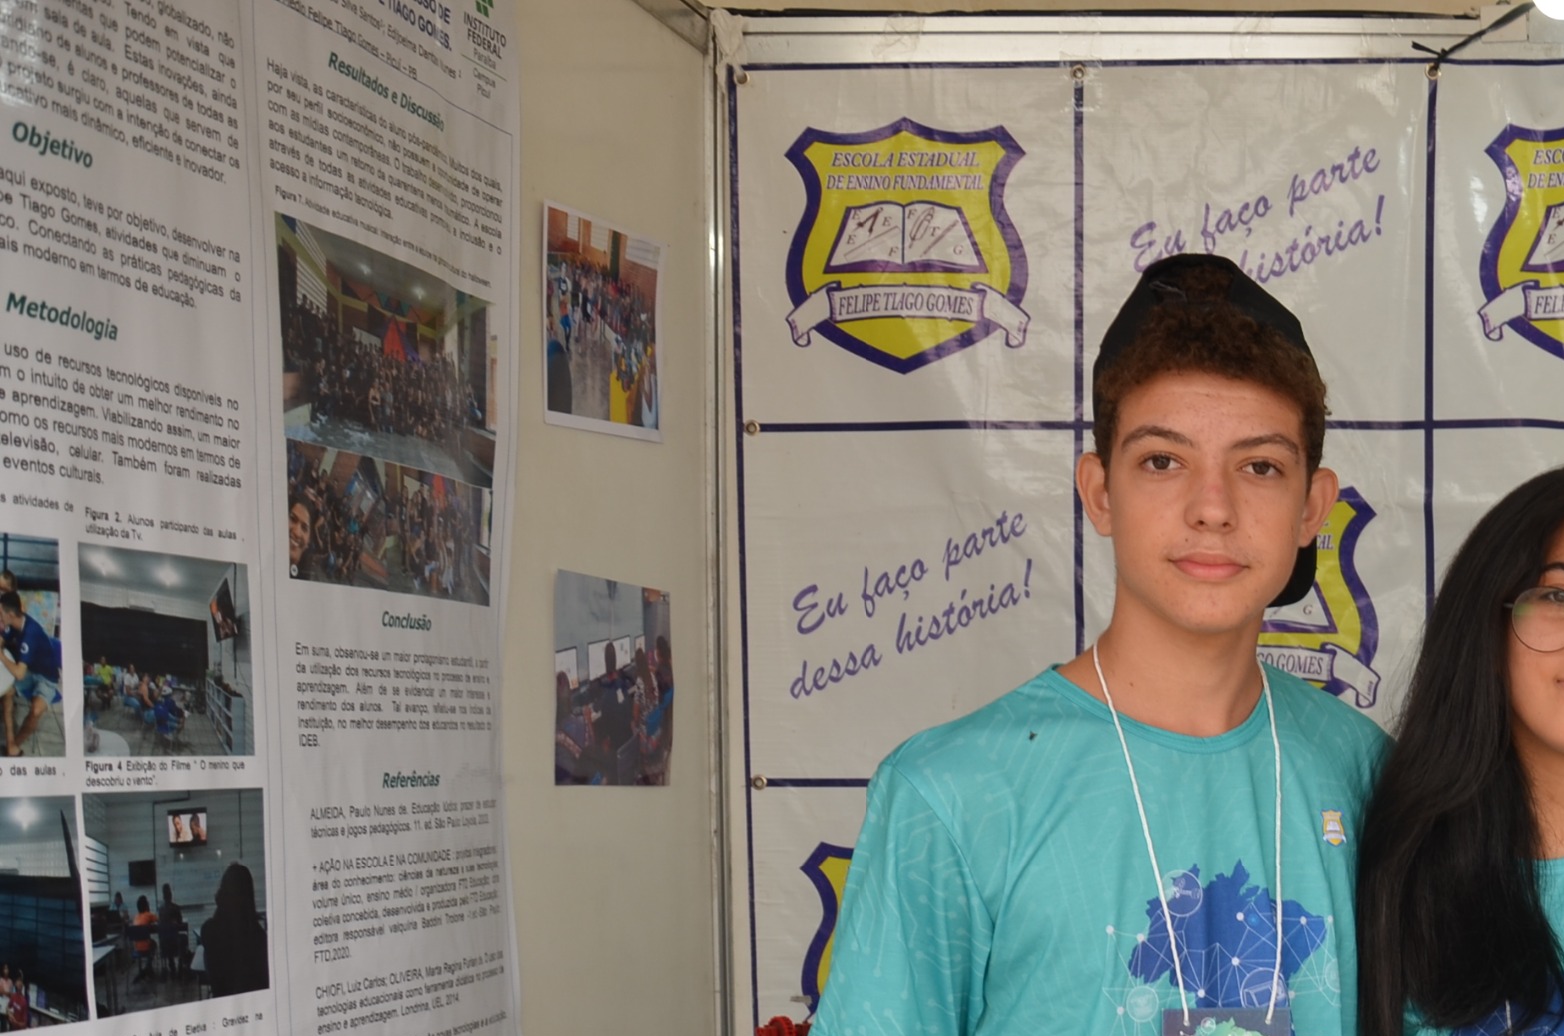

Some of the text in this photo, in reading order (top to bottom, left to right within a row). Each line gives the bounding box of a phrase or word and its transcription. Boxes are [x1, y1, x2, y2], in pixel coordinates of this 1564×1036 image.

[125, 2, 157, 29] Tendo
[463, 12, 507, 48] INSTITUTO
[125, 26, 161, 50] podem
[467, 28, 502, 60] FEDERAL
[124, 44, 154, 70] Estas
[328, 51, 389, 99] Resultados
[391, 91, 398, 104] e
[12, 121, 94, 169] Objetivo
[831, 151, 980, 168] ESCOLA ESTADUAL
[826, 174, 984, 190] DE ENSINO FUNDAMENTAL
[1527, 172, 1545, 189] DE
[31, 176, 80, 207] exposto,
[107, 205, 123, 223] por
[172, 228, 226, 258] desenvolver
[1130, 146, 1380, 274] Eu faço parte
[20, 193, 227, 278] Tiago Gomes, atividades que diminuam
[28, 219, 97, 255] Conectando
[121, 251, 162, 276] práticas
[23, 241, 77, 270] moderno
[97, 265, 131, 288] termos
[134, 276, 149, 293] de
[6, 292, 118, 340] Metodologia
[838, 293, 880, 316] FELIPE
[926, 293, 974, 316] GOMES
[4, 342, 29, 360] uso
[35, 347, 52, 365] de
[58, 354, 102, 377] recursos
[106, 365, 170, 394] tecnológicos
[12, 389, 163, 434] aprendizagem. Viabilizando
[3, 454, 55, 477] eventos
[85, 506, 109, 522] Figura
[792, 510, 1027, 635] Eu faço parte
[381, 611, 432, 631] Conclusão
[789, 558, 1033, 699] dessa história!
[1275, 652, 1324, 676] GOMES
[382, 771, 440, 789] Referências
